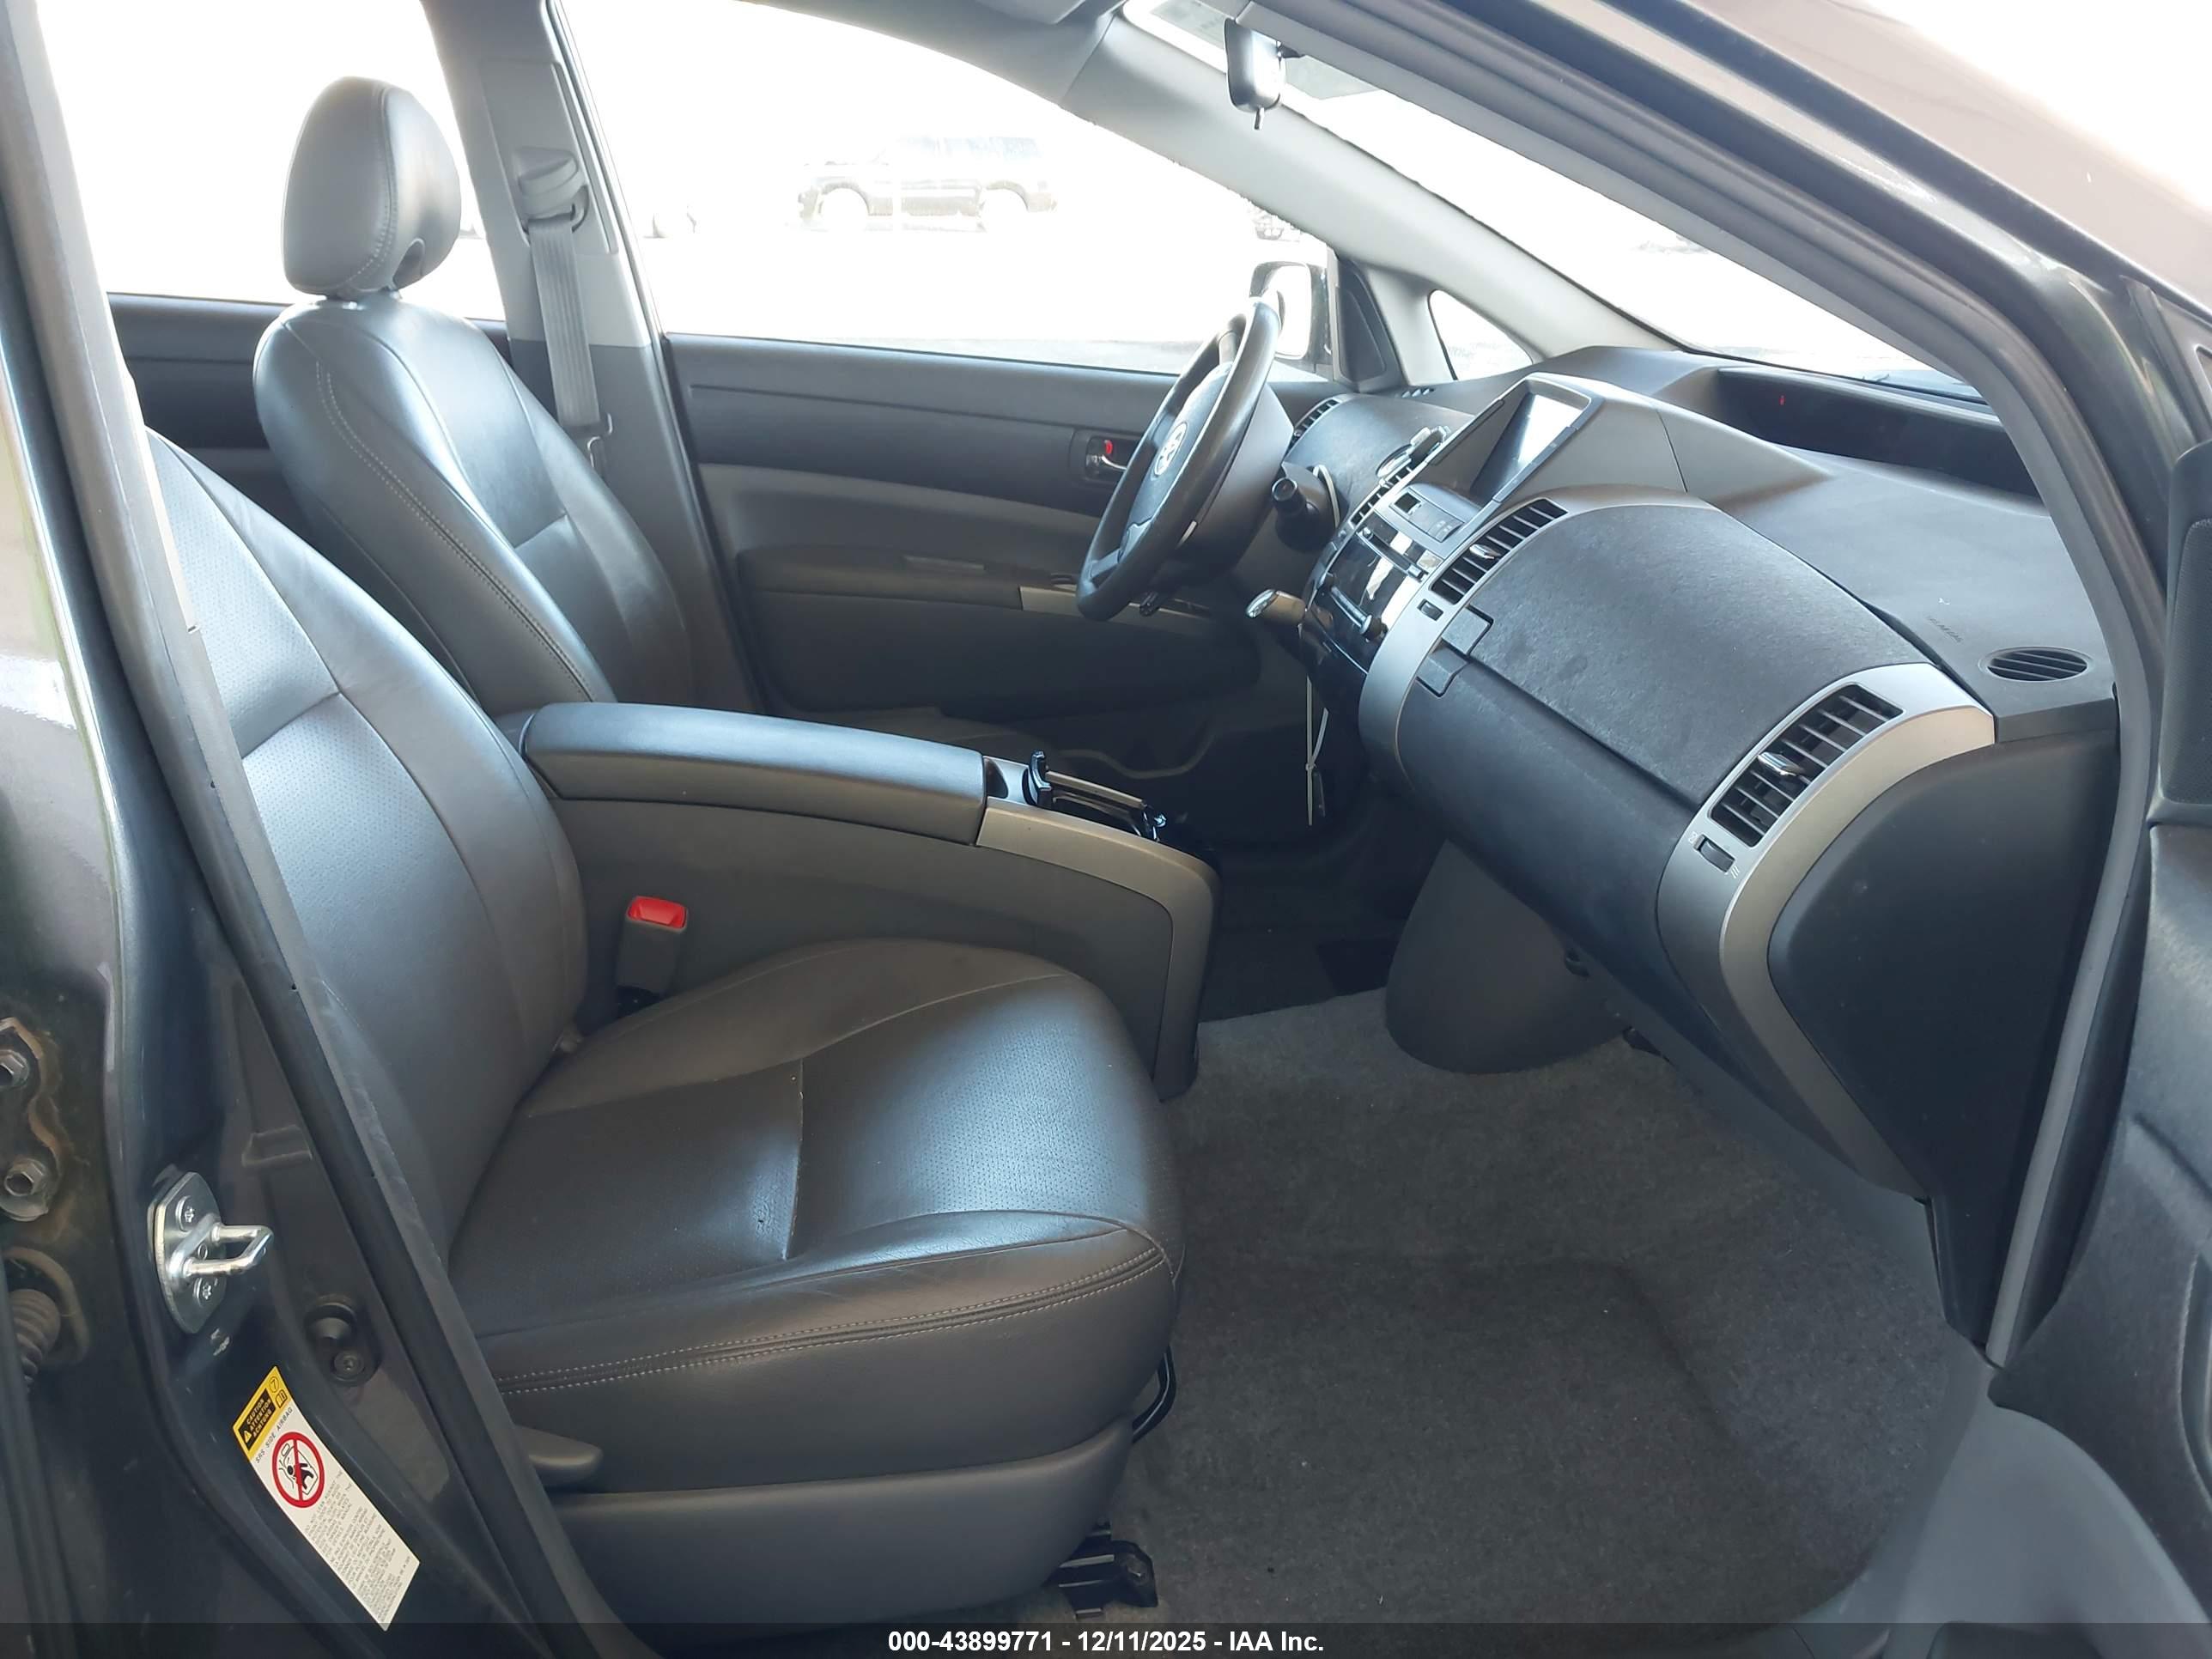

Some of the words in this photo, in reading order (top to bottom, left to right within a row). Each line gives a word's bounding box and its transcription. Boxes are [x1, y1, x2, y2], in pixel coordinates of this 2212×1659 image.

[246, 1398, 264, 1425] CAUTION
[250, 1399, 271, 1431] ATTENTION
[252, 1408, 272, 1437] ACHTUNG
[265, 1432, 276, 1447] SIDE
[276, 1407, 294, 1431] AIRBAG
